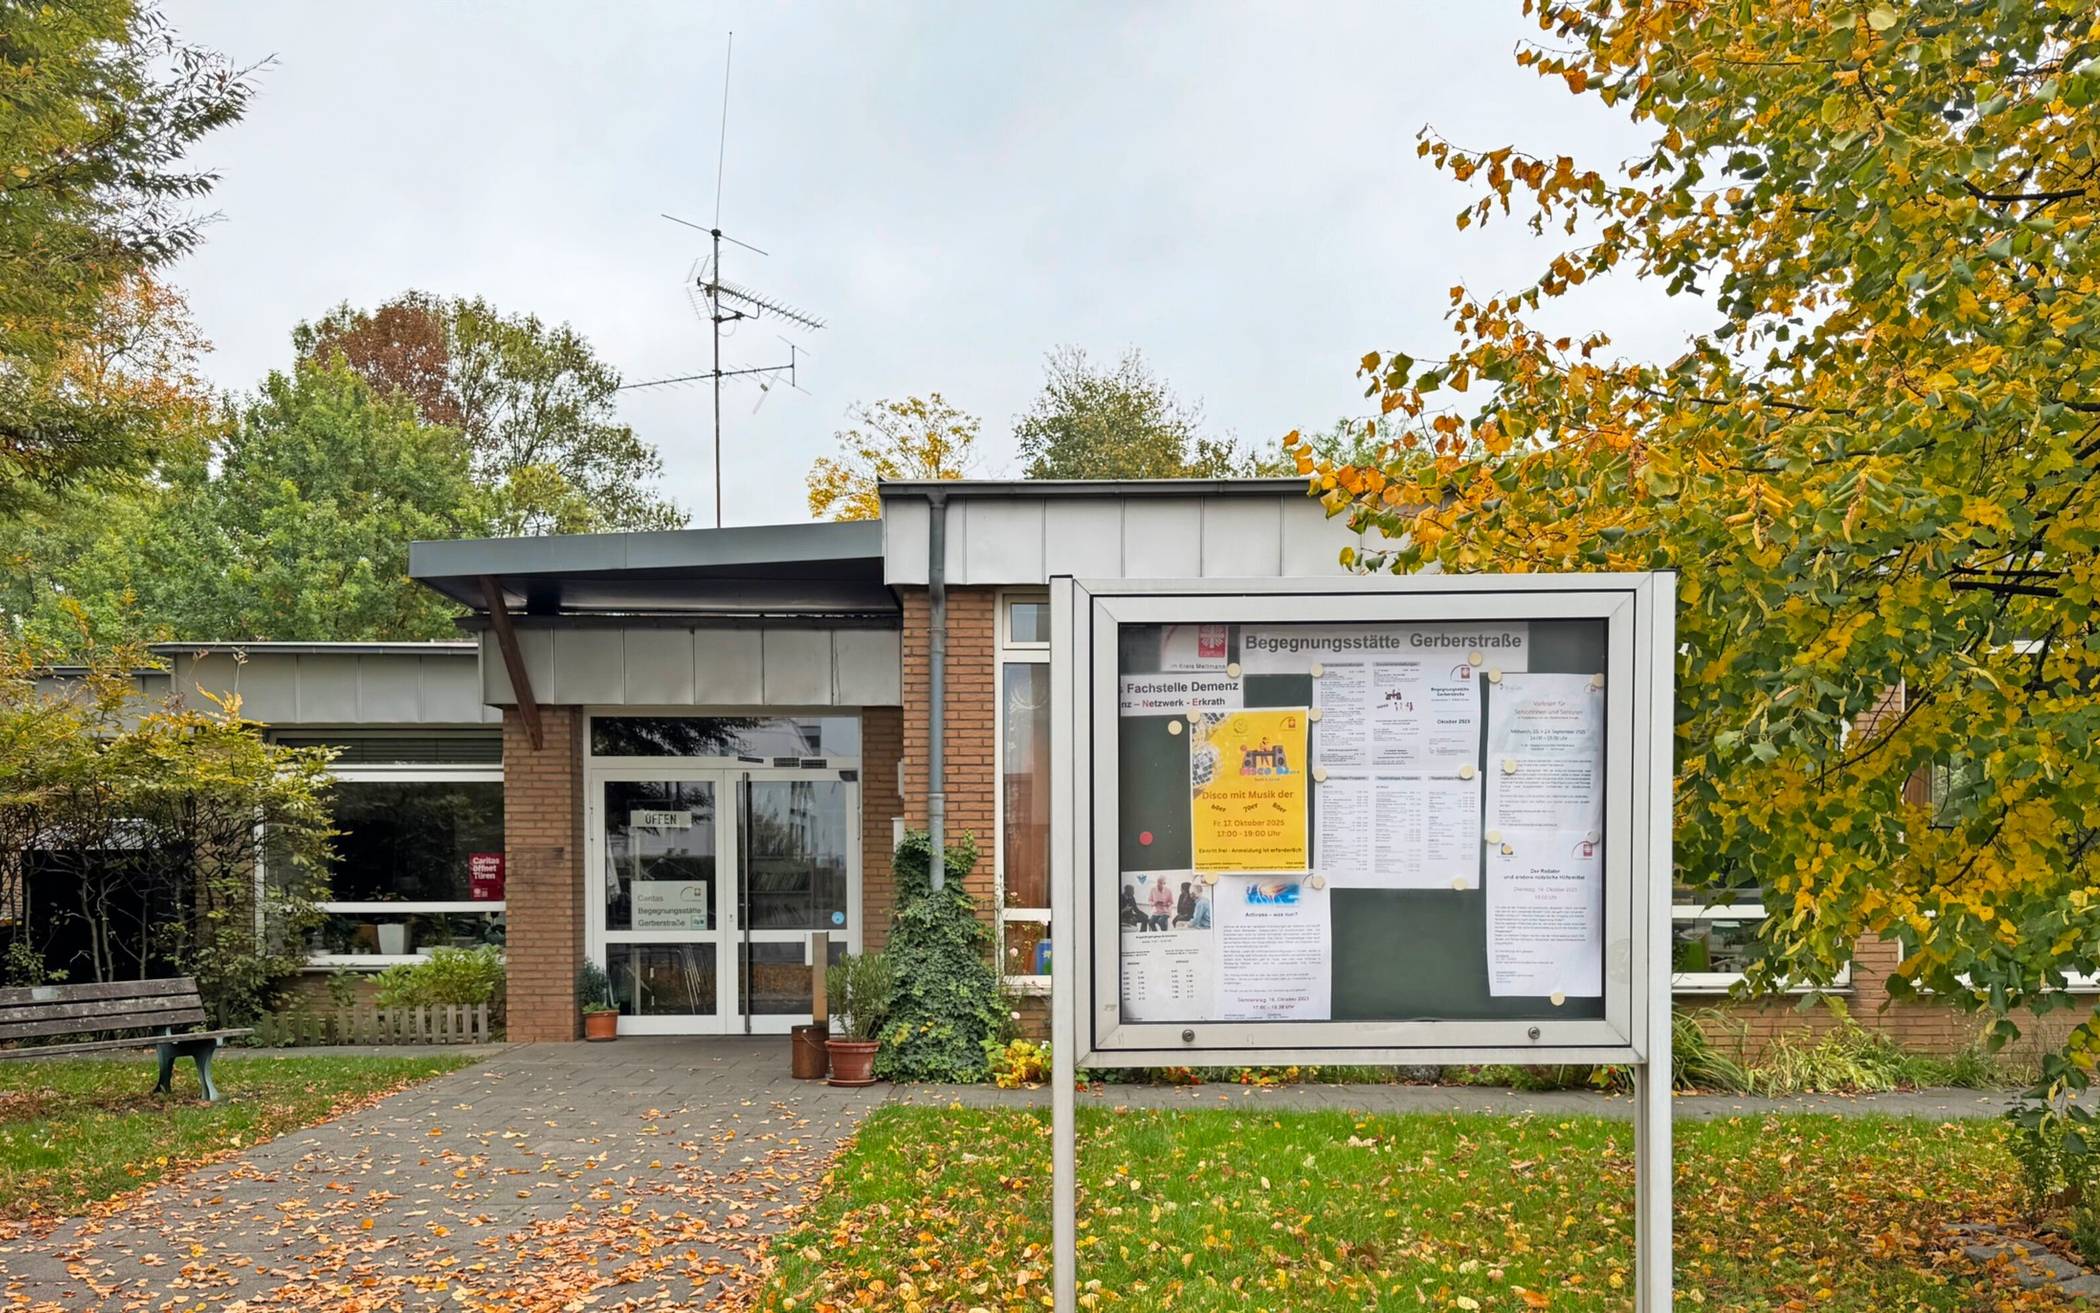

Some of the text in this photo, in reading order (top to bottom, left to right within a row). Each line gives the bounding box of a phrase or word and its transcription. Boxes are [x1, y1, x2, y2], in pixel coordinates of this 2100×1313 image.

[1245, 632, 1522, 652] Begegnungsstätte Gerberstraße
[1127, 682, 1188, 694] Fachstelle
[1191, 681, 1239, 692] Demenz
[1142, 699, 1184, 708] Netzwerk
[1192, 697, 1226, 706] Erkrath
[1202, 789, 1294, 800] Disco mit Musik der
[1233, 819, 1265, 827] Oktober
[1266, 819, 1285, 827] 2025
[1217, 830, 1238, 838] 17:00
[1267, 830, 1281, 838] Uhr
[472, 856, 500, 864] Caritas
[472, 872, 496, 880] Türen
[638, 907, 702, 915] Begegnungsstätte
[638, 919, 686, 927] Gerberstraße
